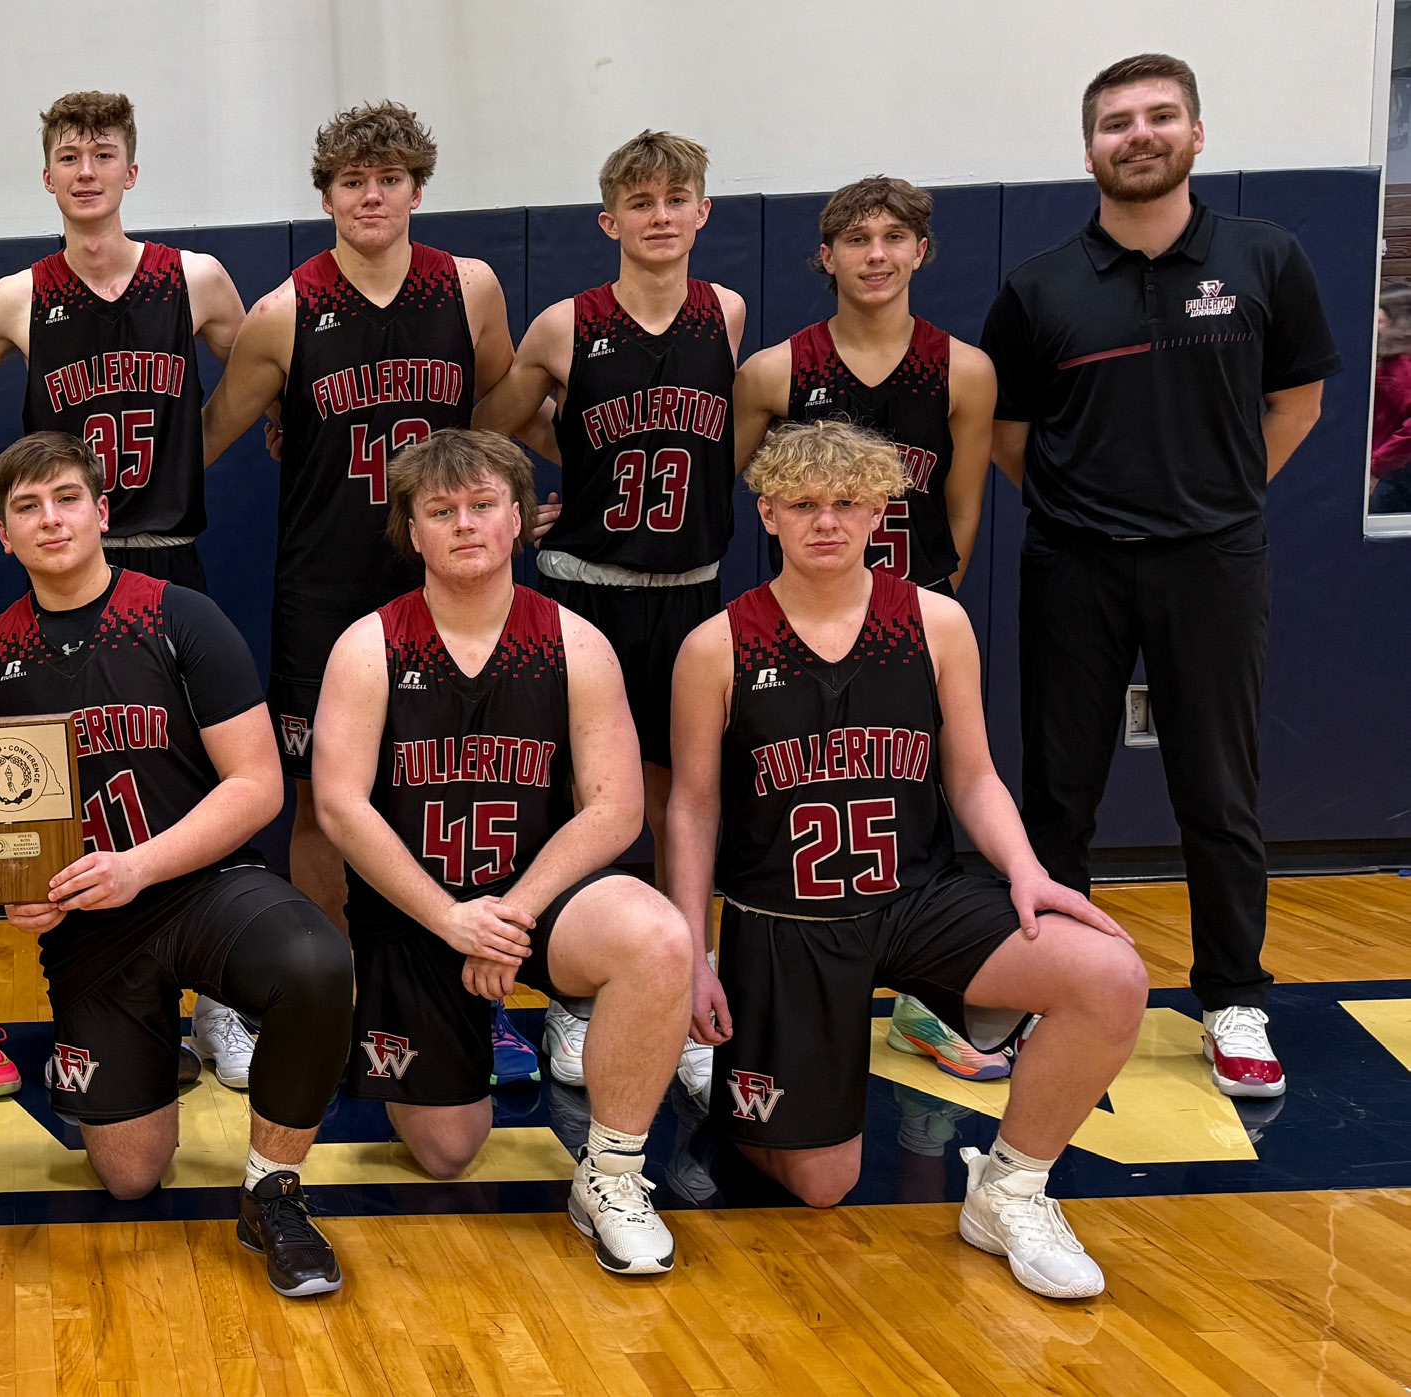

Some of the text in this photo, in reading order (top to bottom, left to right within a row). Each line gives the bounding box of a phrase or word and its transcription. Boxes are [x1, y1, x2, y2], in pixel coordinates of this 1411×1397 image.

[45, 315, 70, 324] RUSSELL
[314, 321, 341, 332] RUSSELL
[1185, 295, 1237, 313] FULLERTON
[587, 347, 615, 358] RUSSELL
[44, 351, 185, 413] FULLERTON
[312, 358, 463, 421] FULLERTON
[804, 398, 833, 407] RUSSELL
[582, 386, 727, 450] FULLERTON
[84, 409, 154, 493] 35
[604, 448, 691, 532] 33
[0, 671, 27, 681] RUSSELL
[751, 680, 786, 691] RUSSELL
[8, 744, 41, 784] CONFERENCE
[393, 734, 556, 788] FULLERTON
[751, 727, 931, 796] FULLERTON
[423, 801, 517, 886] 45
[791, 798, 899, 899] 25
